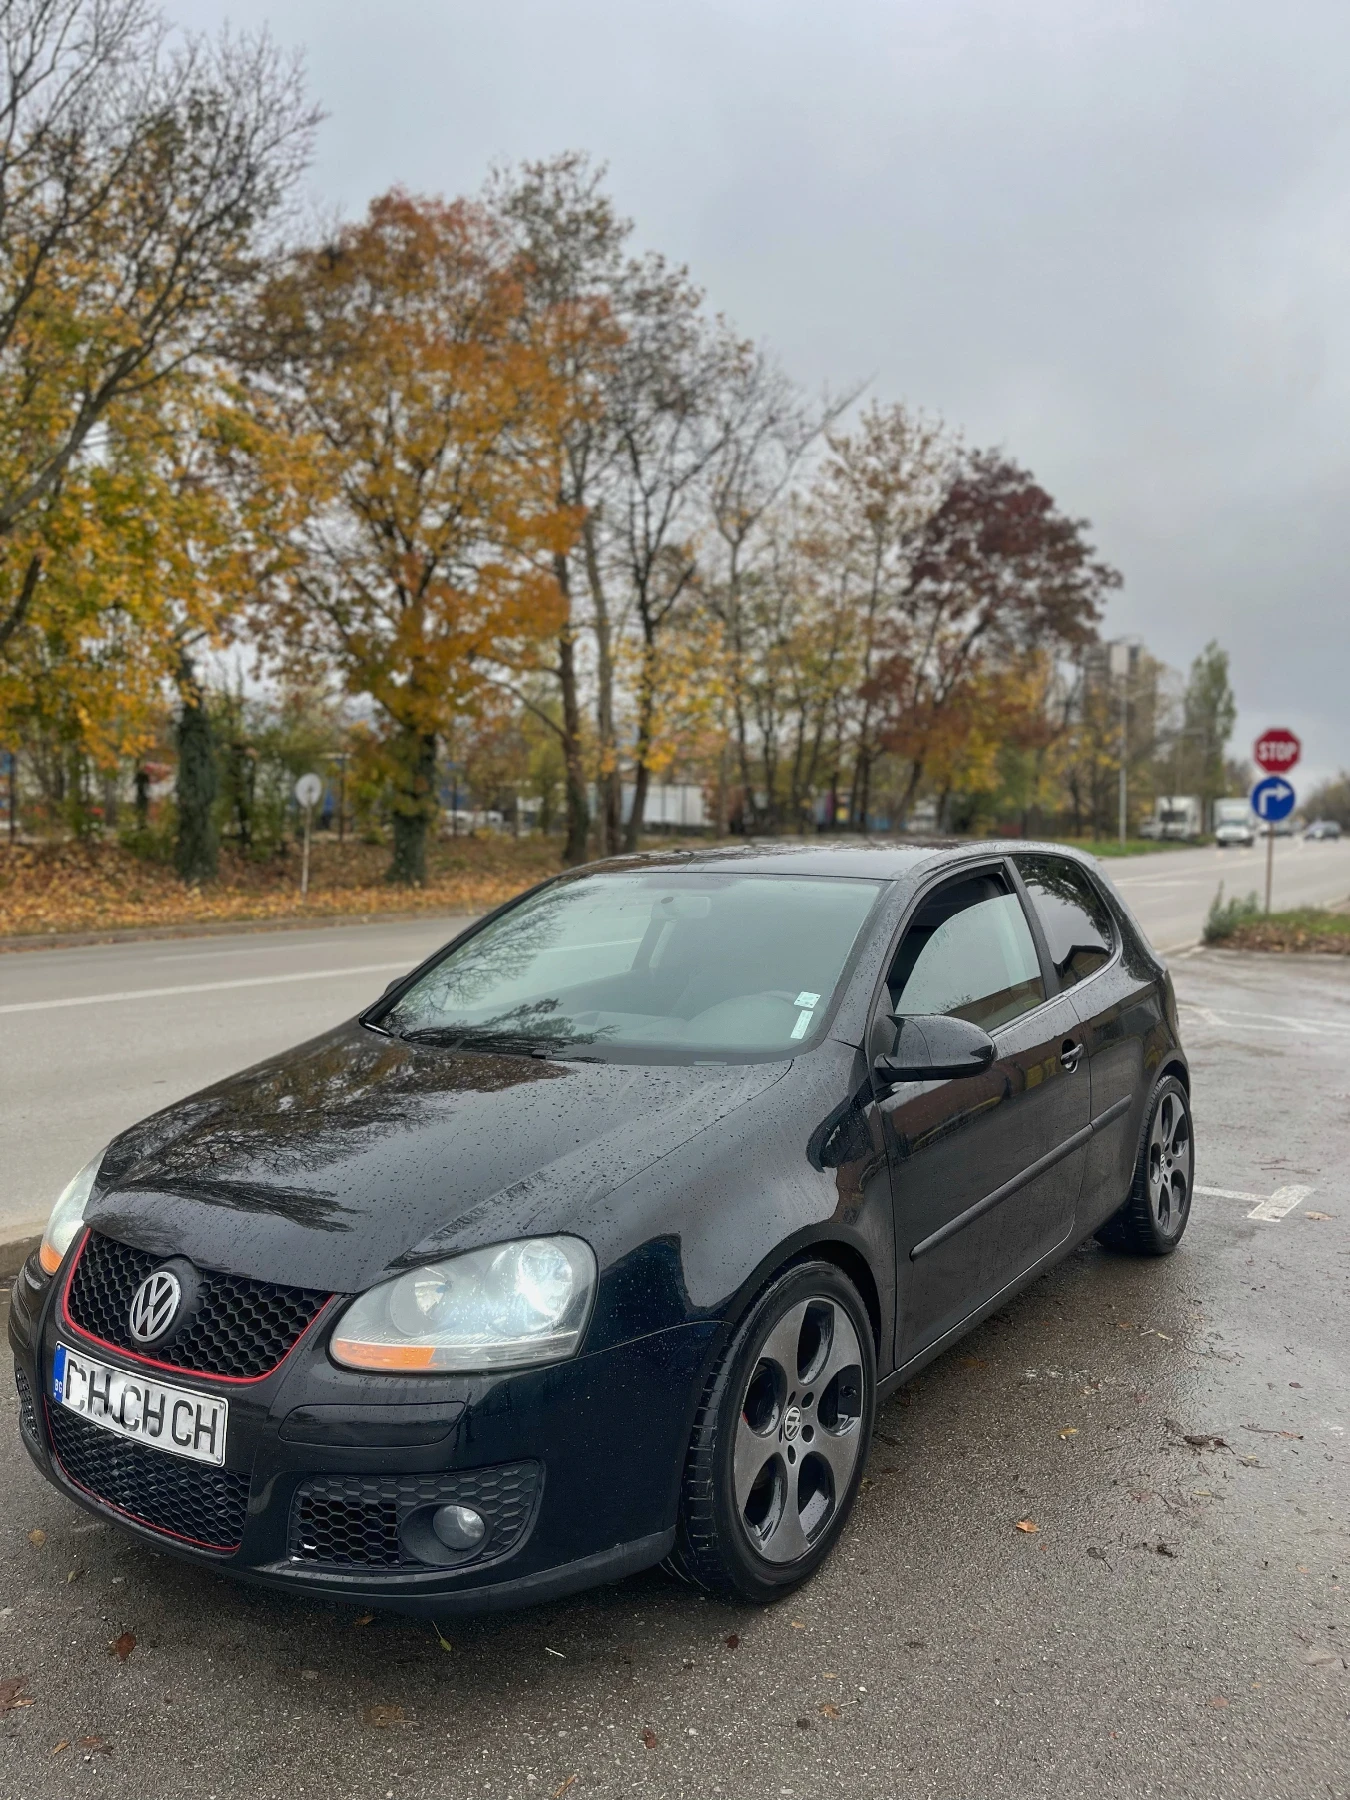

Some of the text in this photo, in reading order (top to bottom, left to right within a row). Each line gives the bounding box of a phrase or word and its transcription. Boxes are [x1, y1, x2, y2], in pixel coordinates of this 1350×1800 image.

[1258, 741, 1297, 762] STOP
[130, 1272, 182, 1342] VW
[54, 1379, 63, 1394] BG
